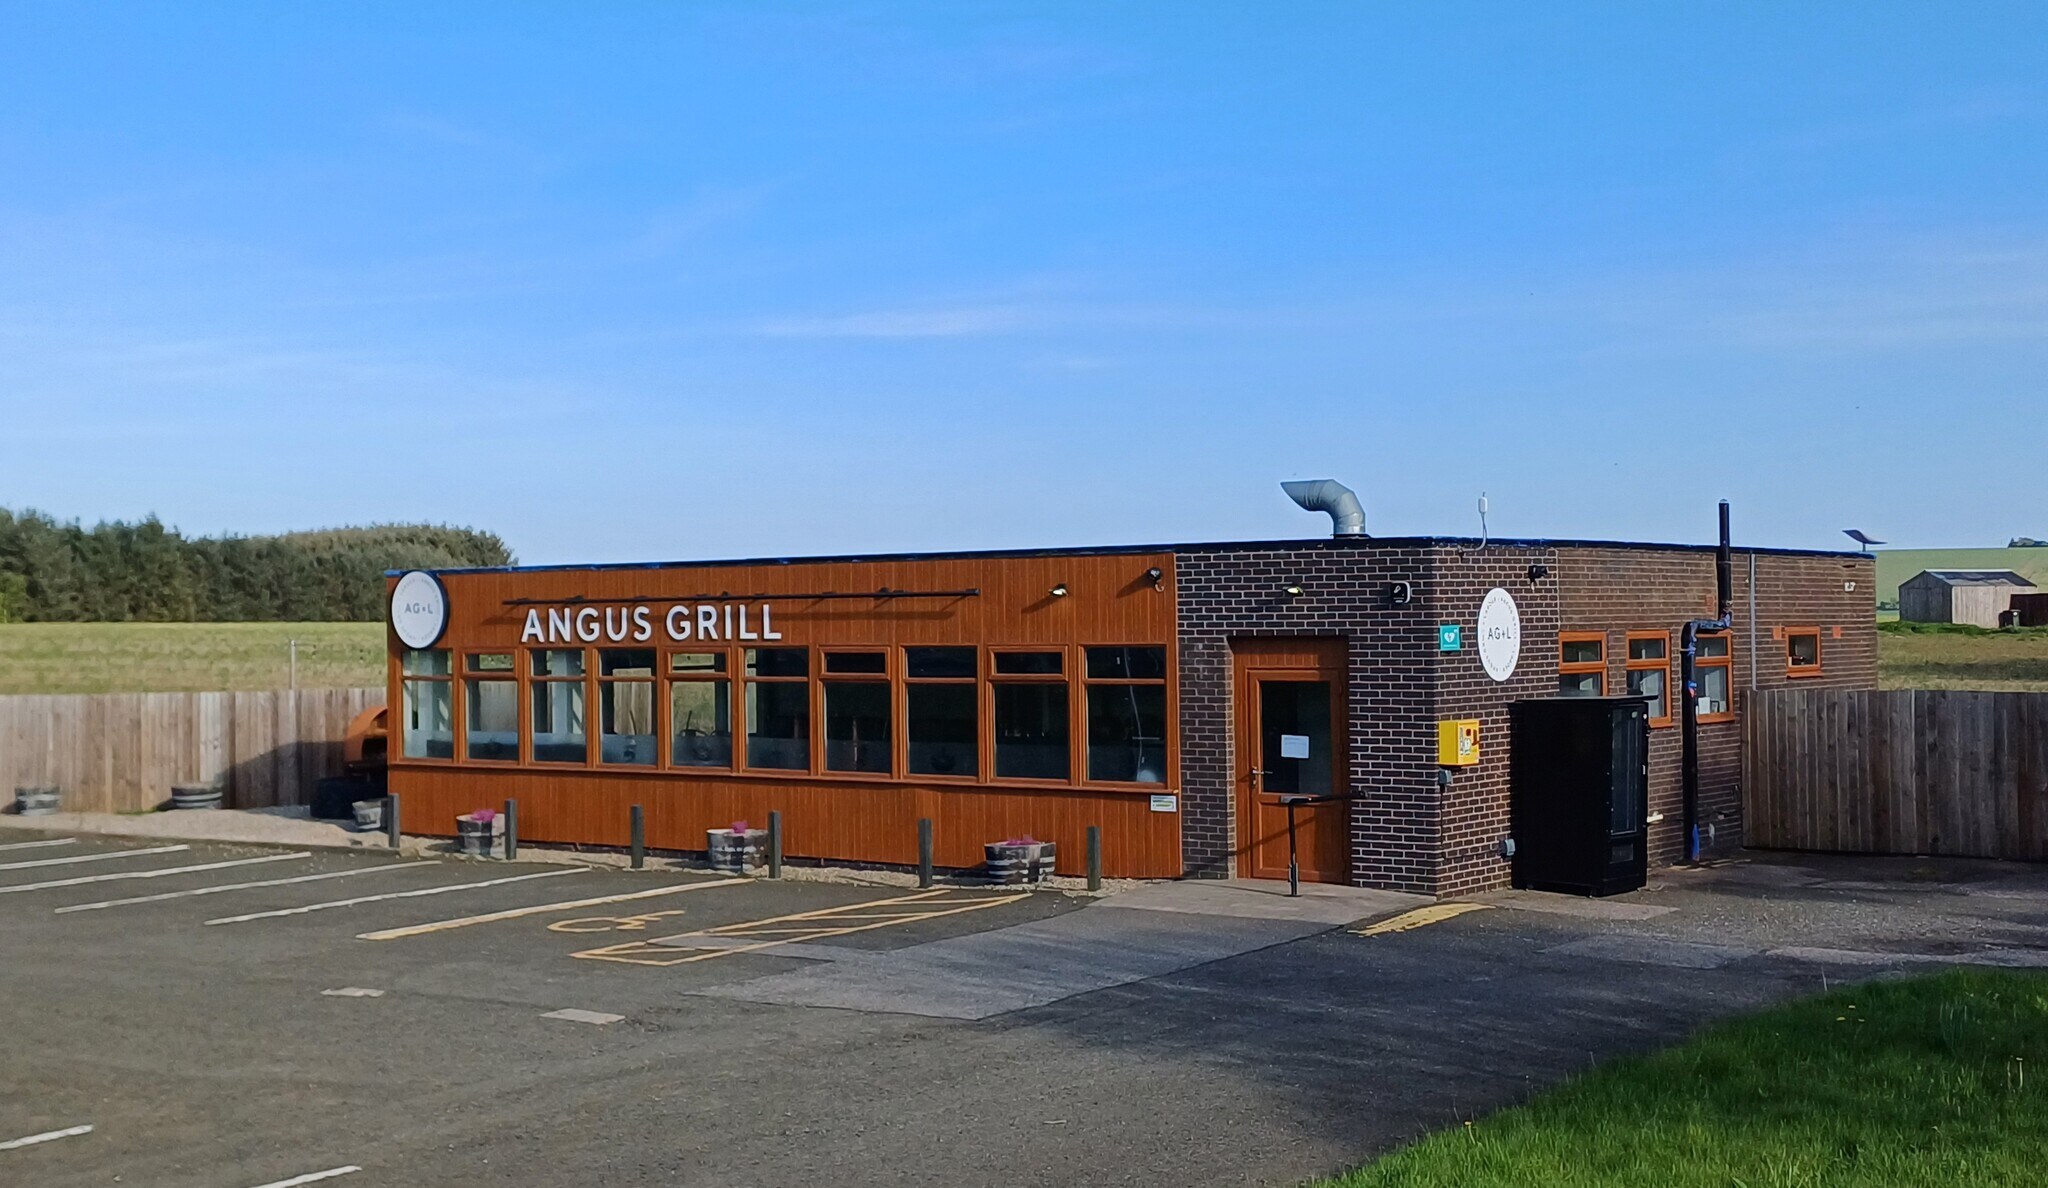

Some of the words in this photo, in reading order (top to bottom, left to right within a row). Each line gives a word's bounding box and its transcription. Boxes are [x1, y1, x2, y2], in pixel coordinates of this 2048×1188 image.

[521, 607, 651, 643] ANGUS
[666, 604, 782, 641] GRILL
[1487, 626, 1512, 640] AG+L
